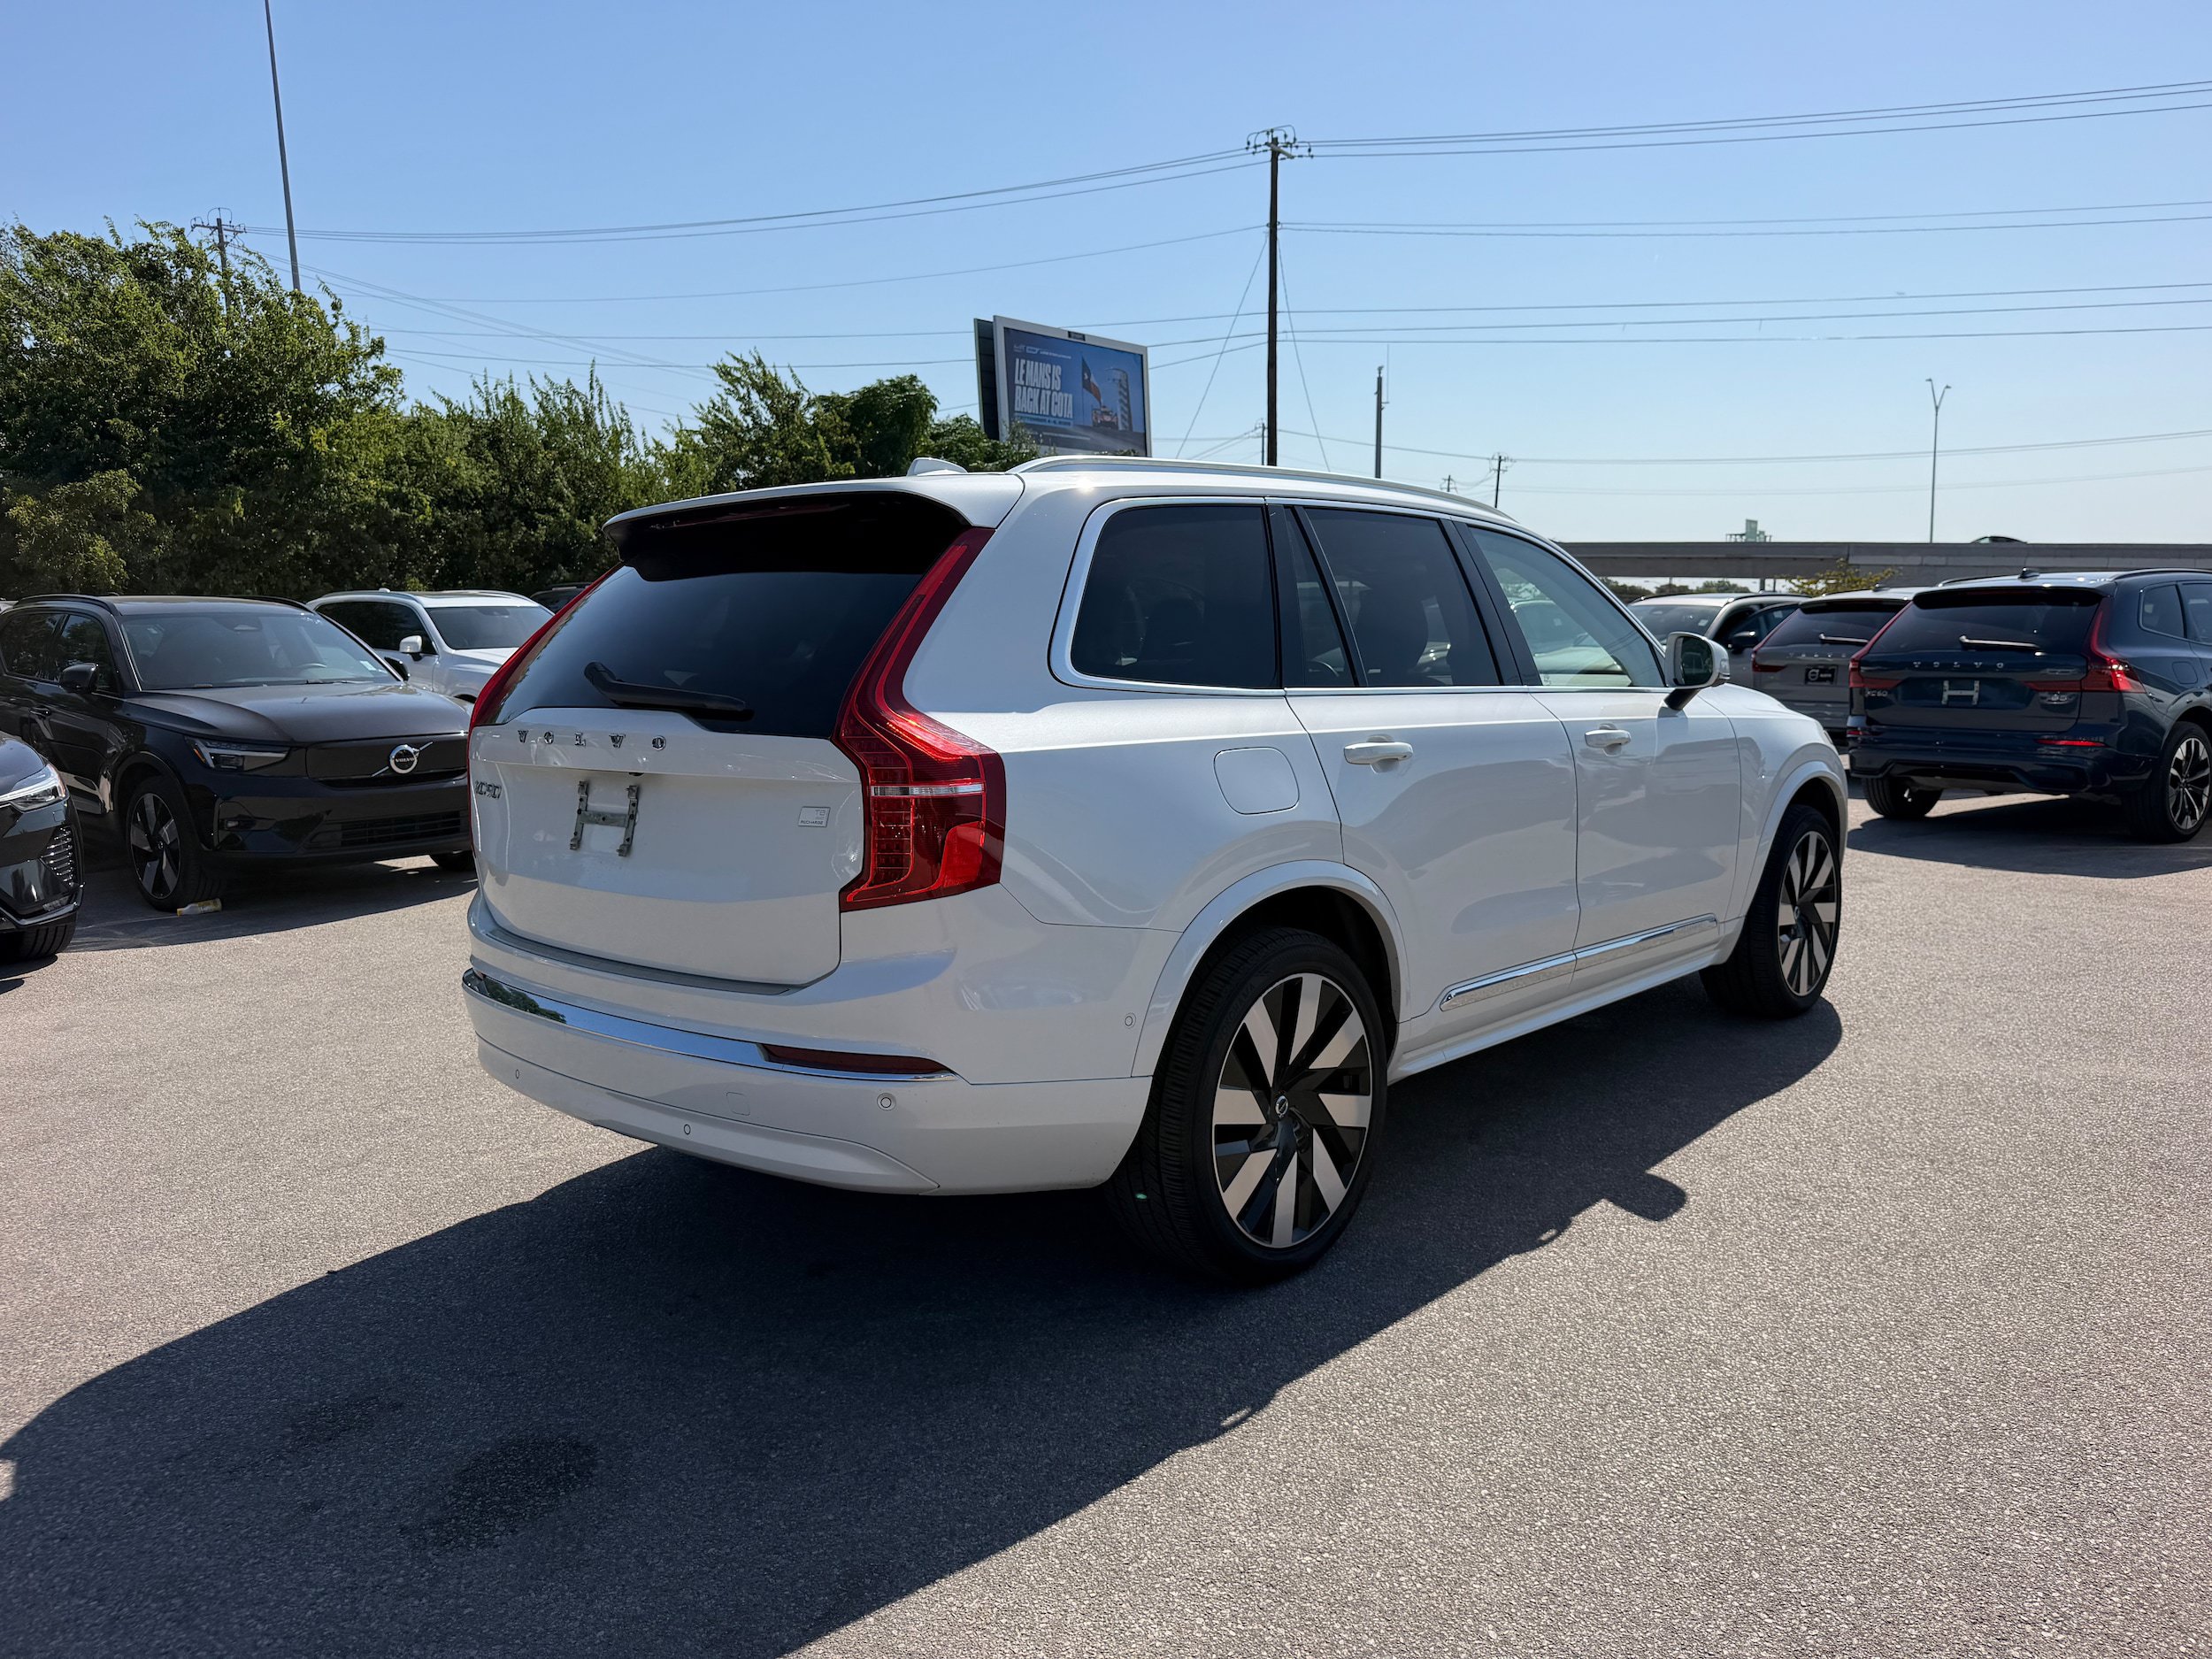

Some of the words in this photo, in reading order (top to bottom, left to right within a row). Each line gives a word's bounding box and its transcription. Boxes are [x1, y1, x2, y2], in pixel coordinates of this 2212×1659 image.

[1014, 358, 1025, 385] LE
[1025, 360, 1051, 389] MANS
[1052, 364, 1062, 391] IS
[1014, 386, 1040, 414] BACK
[1040, 389, 1051, 415] AT
[1051, 392, 1073, 419] COTA
[517, 729, 667, 751] VOLVO
